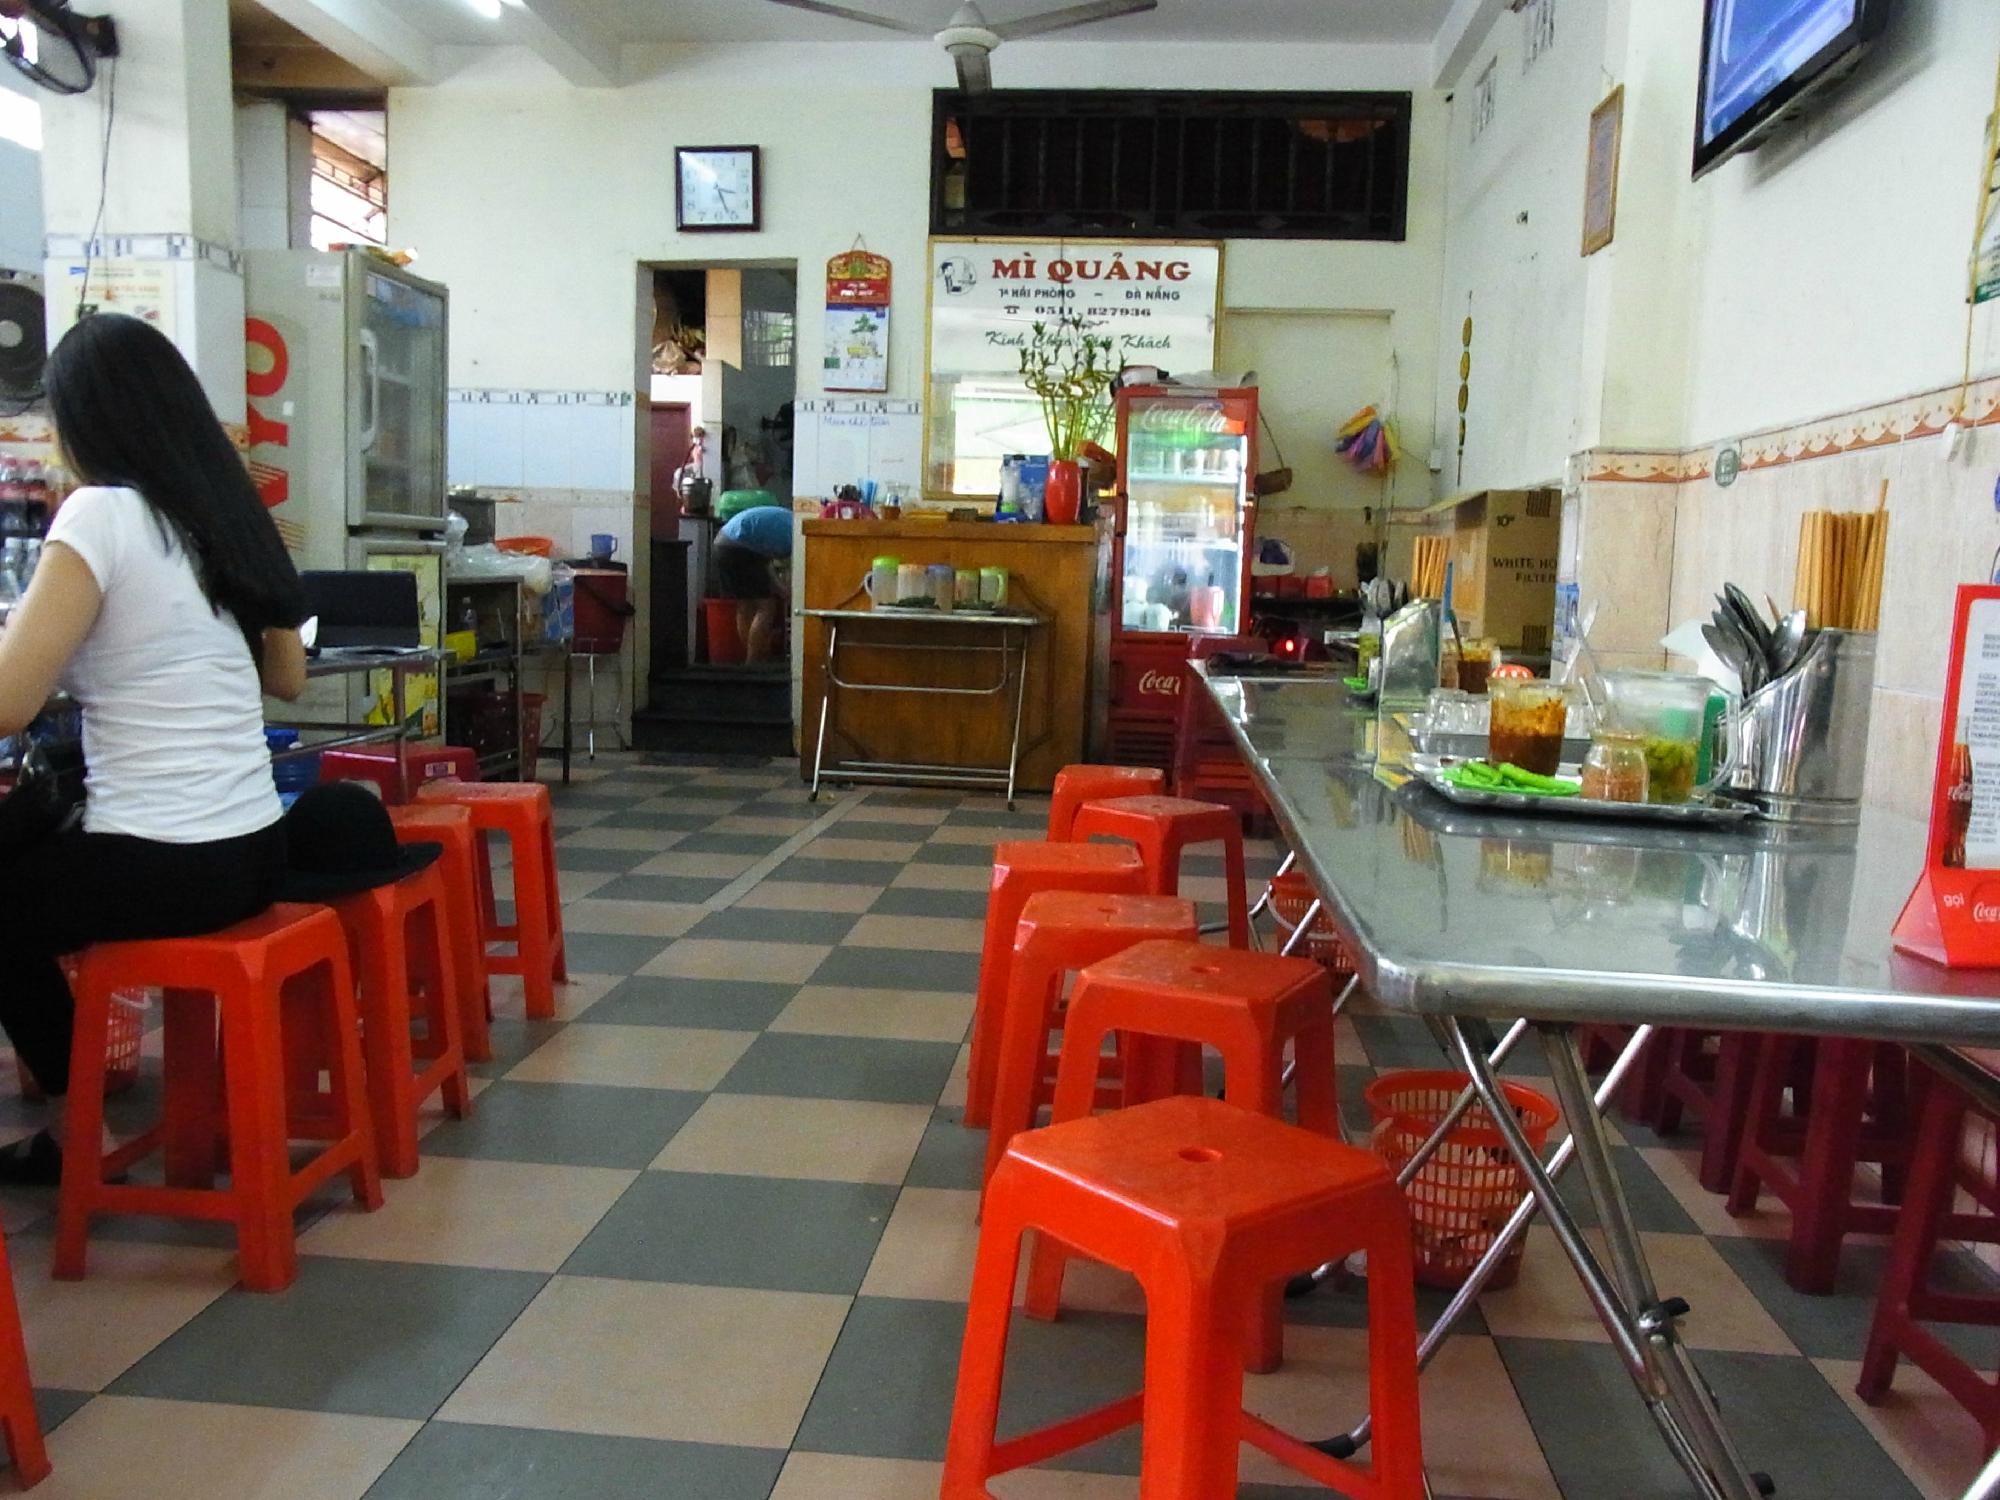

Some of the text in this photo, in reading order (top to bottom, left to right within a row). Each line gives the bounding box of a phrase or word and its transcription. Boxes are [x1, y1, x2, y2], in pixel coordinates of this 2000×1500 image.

[992, 251, 1191, 283] MÌ QUẢNG
[1493, 557, 1535, 569] WHITE
